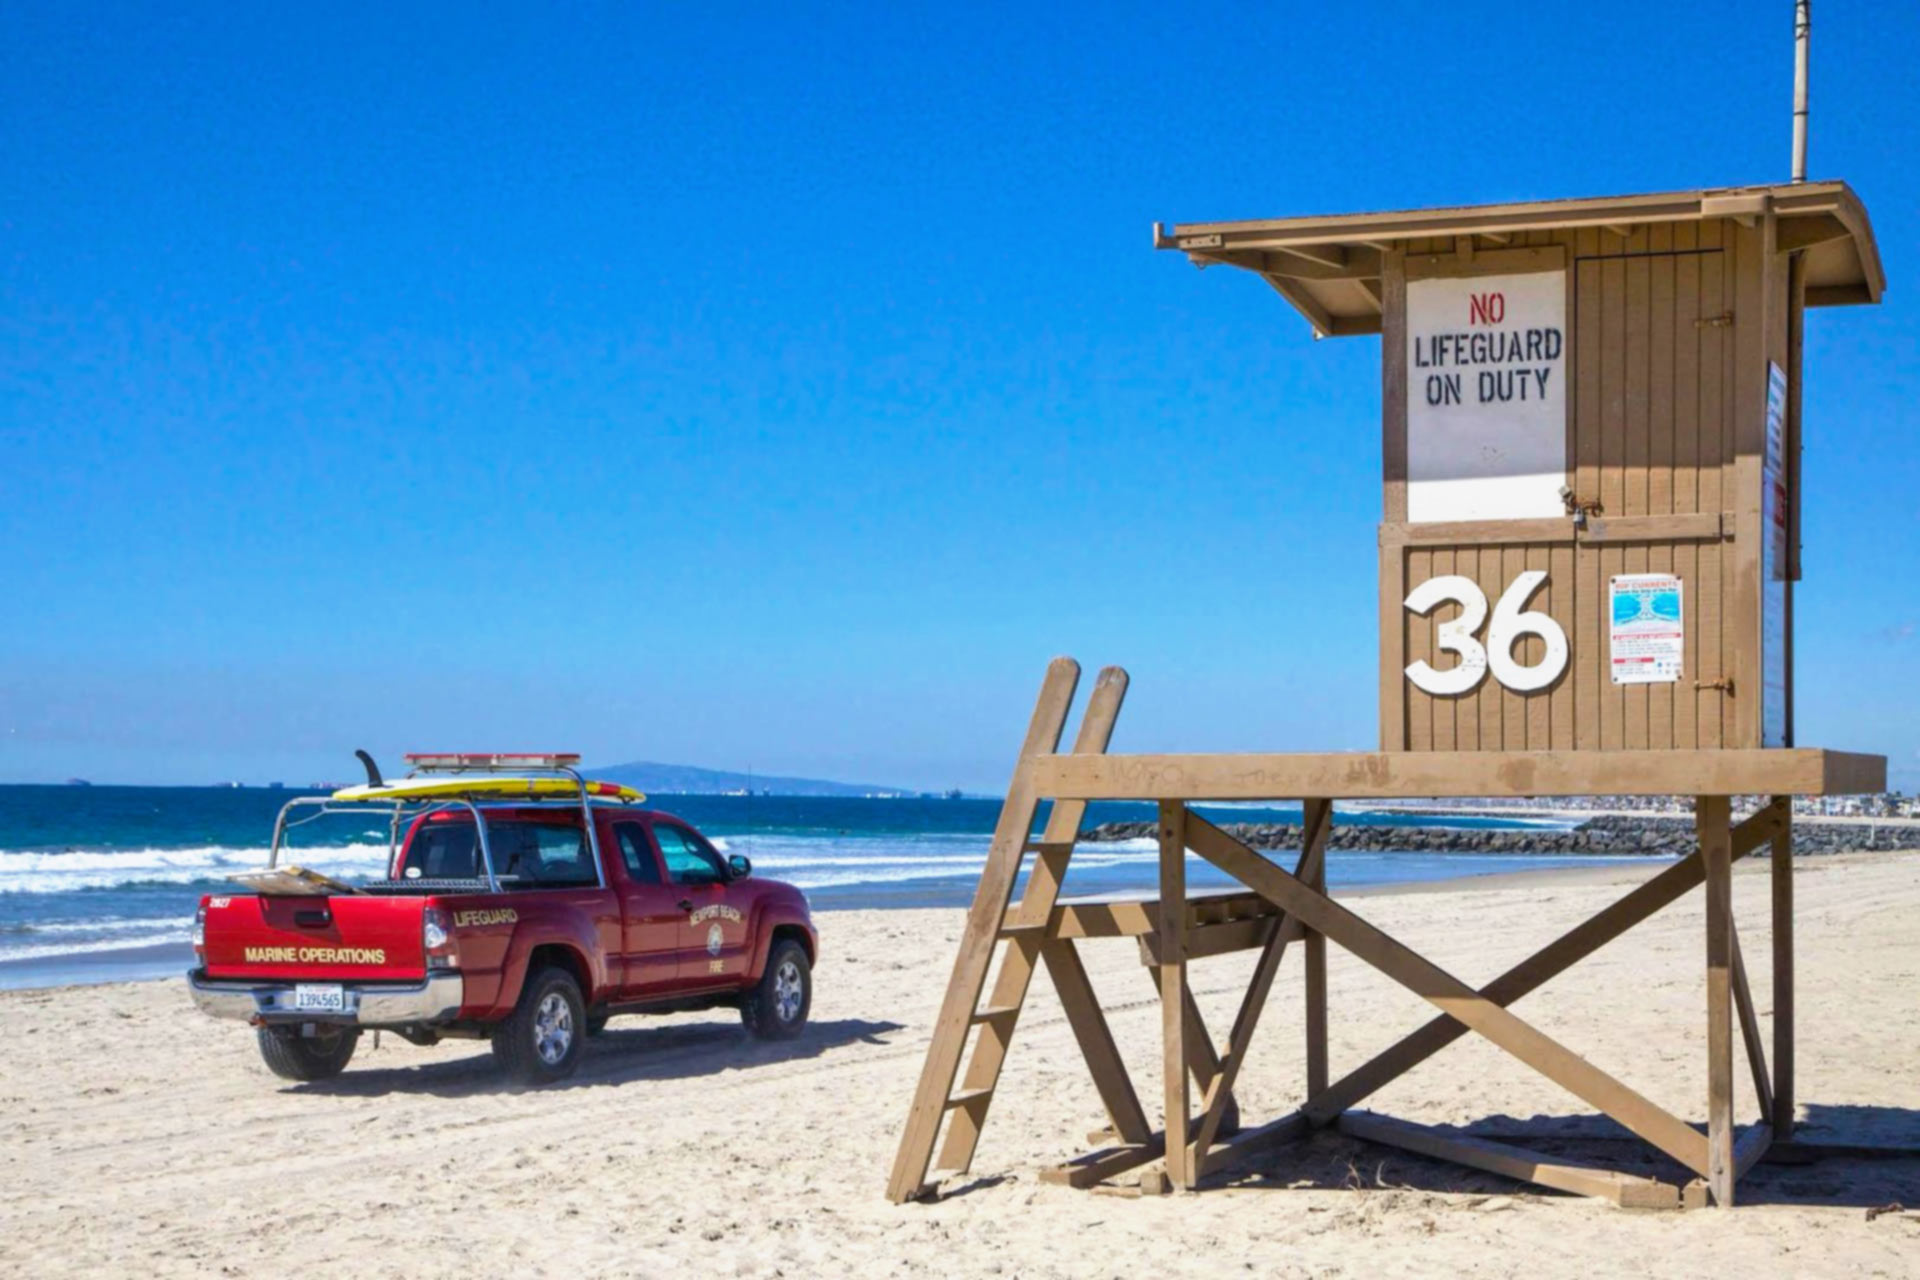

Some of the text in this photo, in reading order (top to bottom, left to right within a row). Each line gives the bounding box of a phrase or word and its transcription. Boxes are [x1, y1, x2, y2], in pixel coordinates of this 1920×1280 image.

[1470, 292, 1505, 325] NO
[1415, 327, 1562, 368] LIFEGUARD
[1427, 367, 1550, 406] ON DUTY
[1403, 570, 1568, 694] 36
[453, 908, 518, 927] LIFEGUARD
[245, 947, 386, 964] MARINE OPERATIONS
